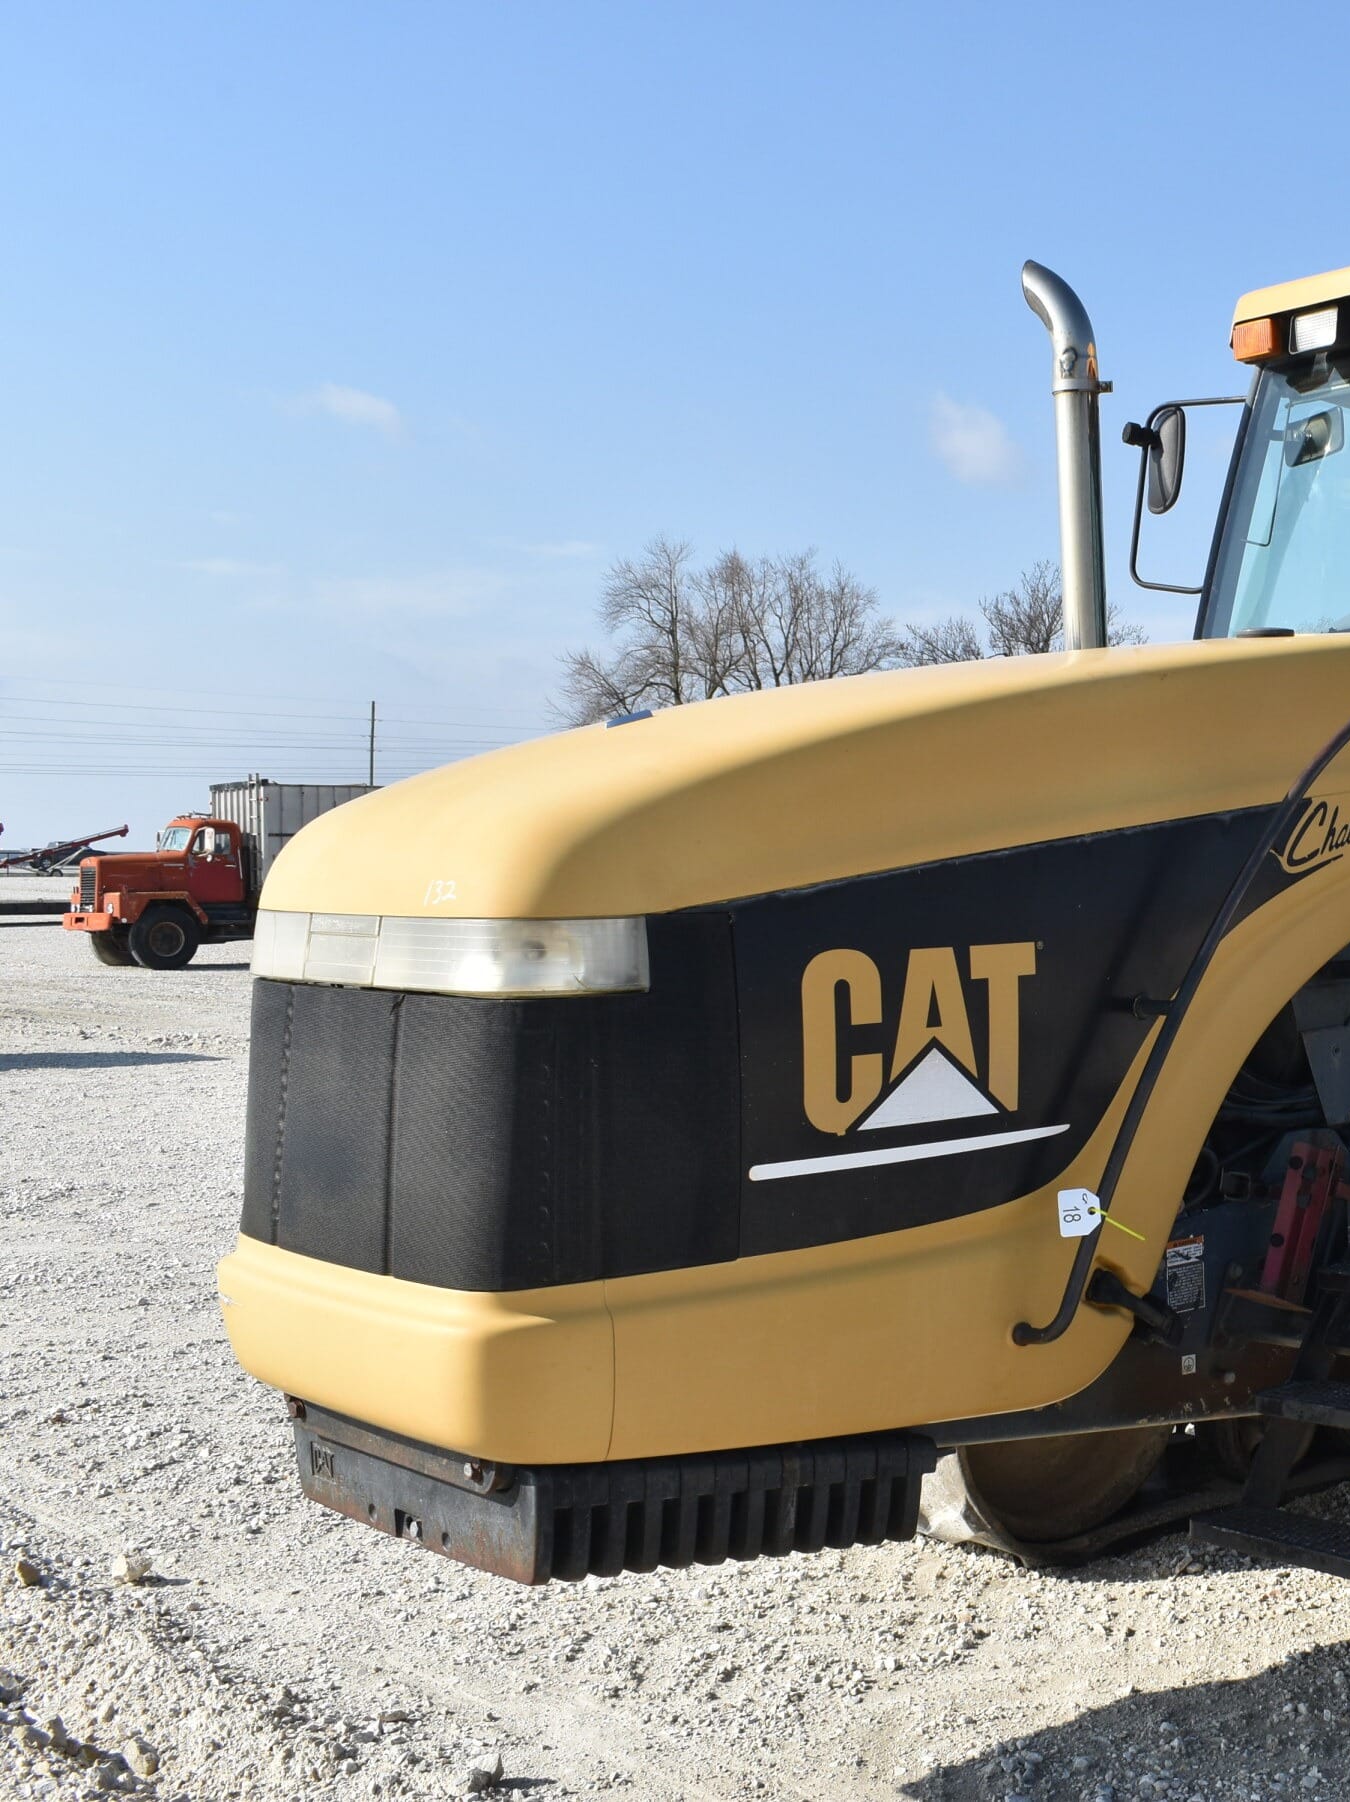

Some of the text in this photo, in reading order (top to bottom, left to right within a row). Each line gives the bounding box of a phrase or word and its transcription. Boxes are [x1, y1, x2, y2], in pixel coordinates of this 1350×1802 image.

[423, 879, 457, 907] 132
[801, 941, 1037, 1136] CAT
[1063, 1206, 1082, 1223] 18
[310, 1440, 336, 1481] CAT
